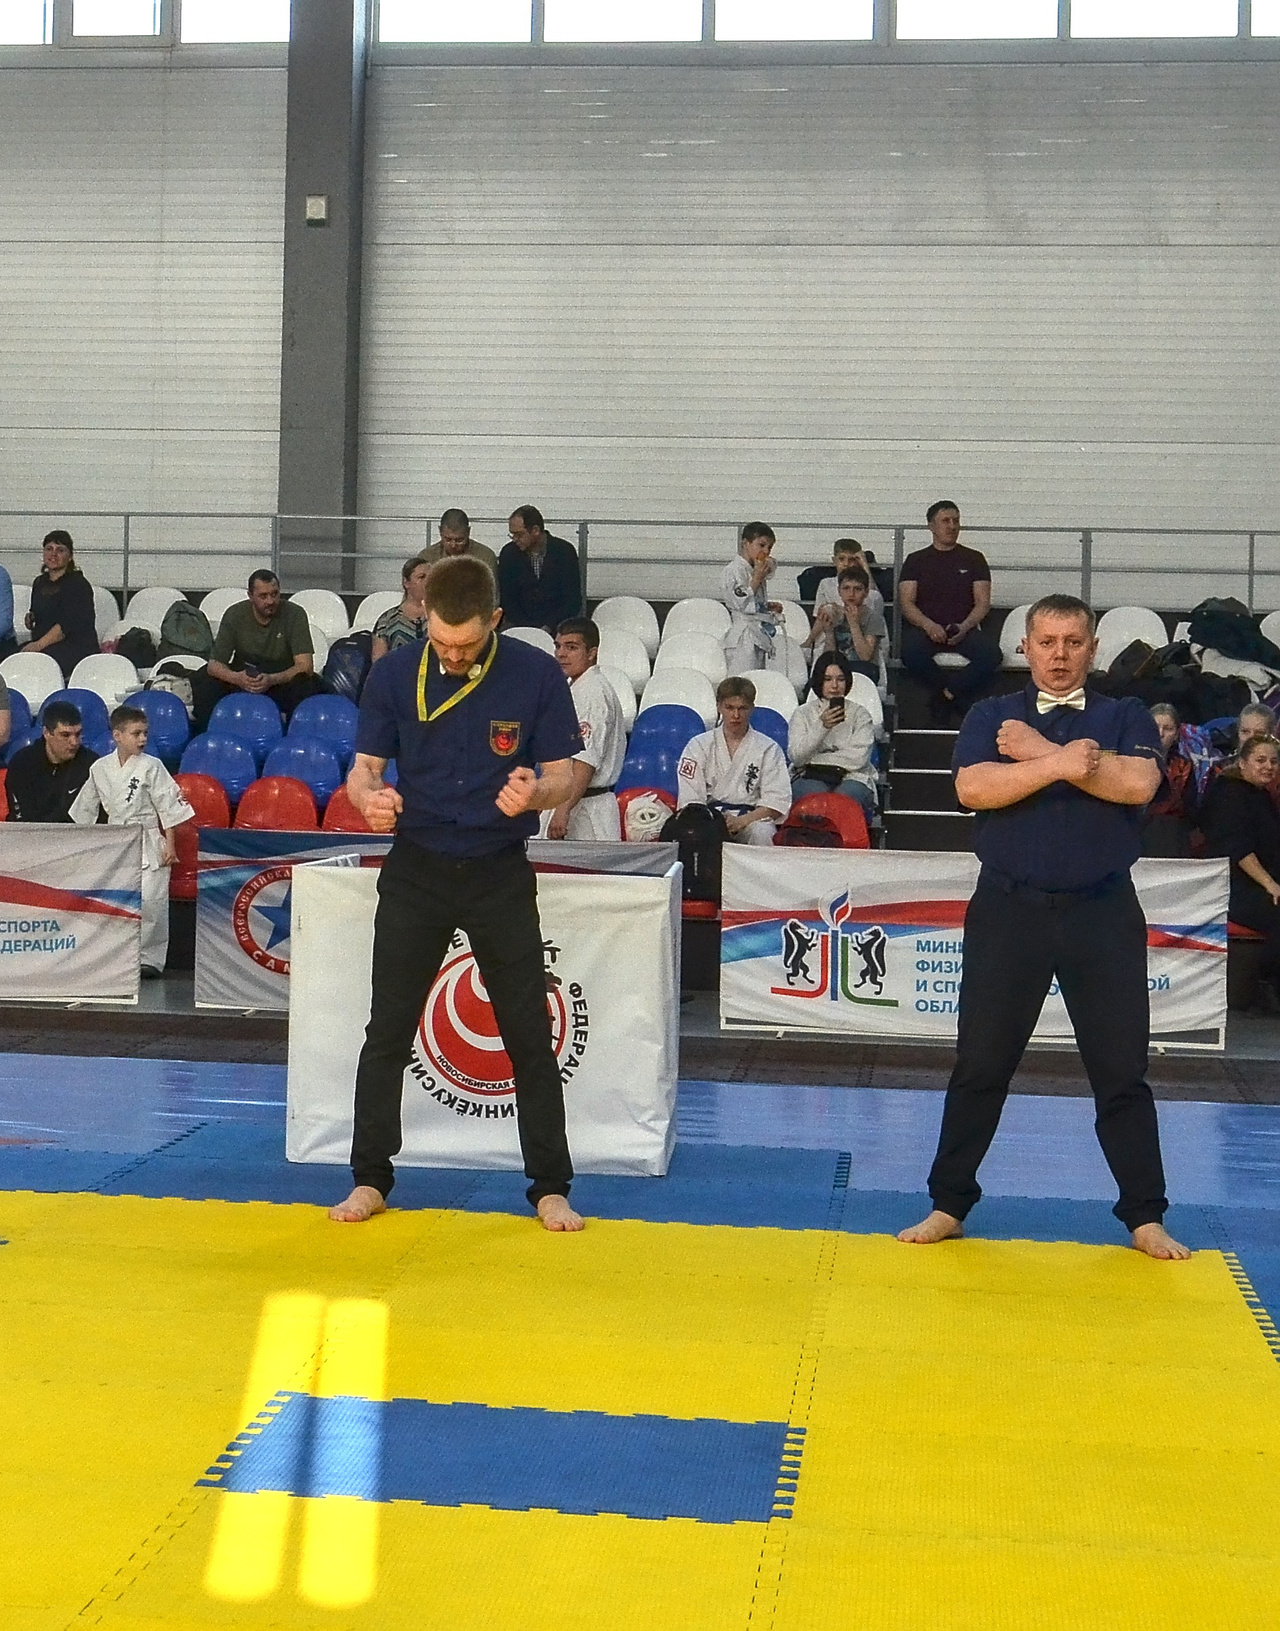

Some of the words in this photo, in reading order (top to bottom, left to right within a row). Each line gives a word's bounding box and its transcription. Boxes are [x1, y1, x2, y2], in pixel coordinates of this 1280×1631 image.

[237, 870, 291, 941] ВСЕРОССИЙСКА
[916, 959, 962, 973] ФИЗИ
[916, 979, 928, 992] И
[933, 980, 961, 993] СП
[561, 981, 589, 1085] ФЕДЕРАЦ
[436, 1054, 510, 1090] НОВОСИБИРСКАЯ
